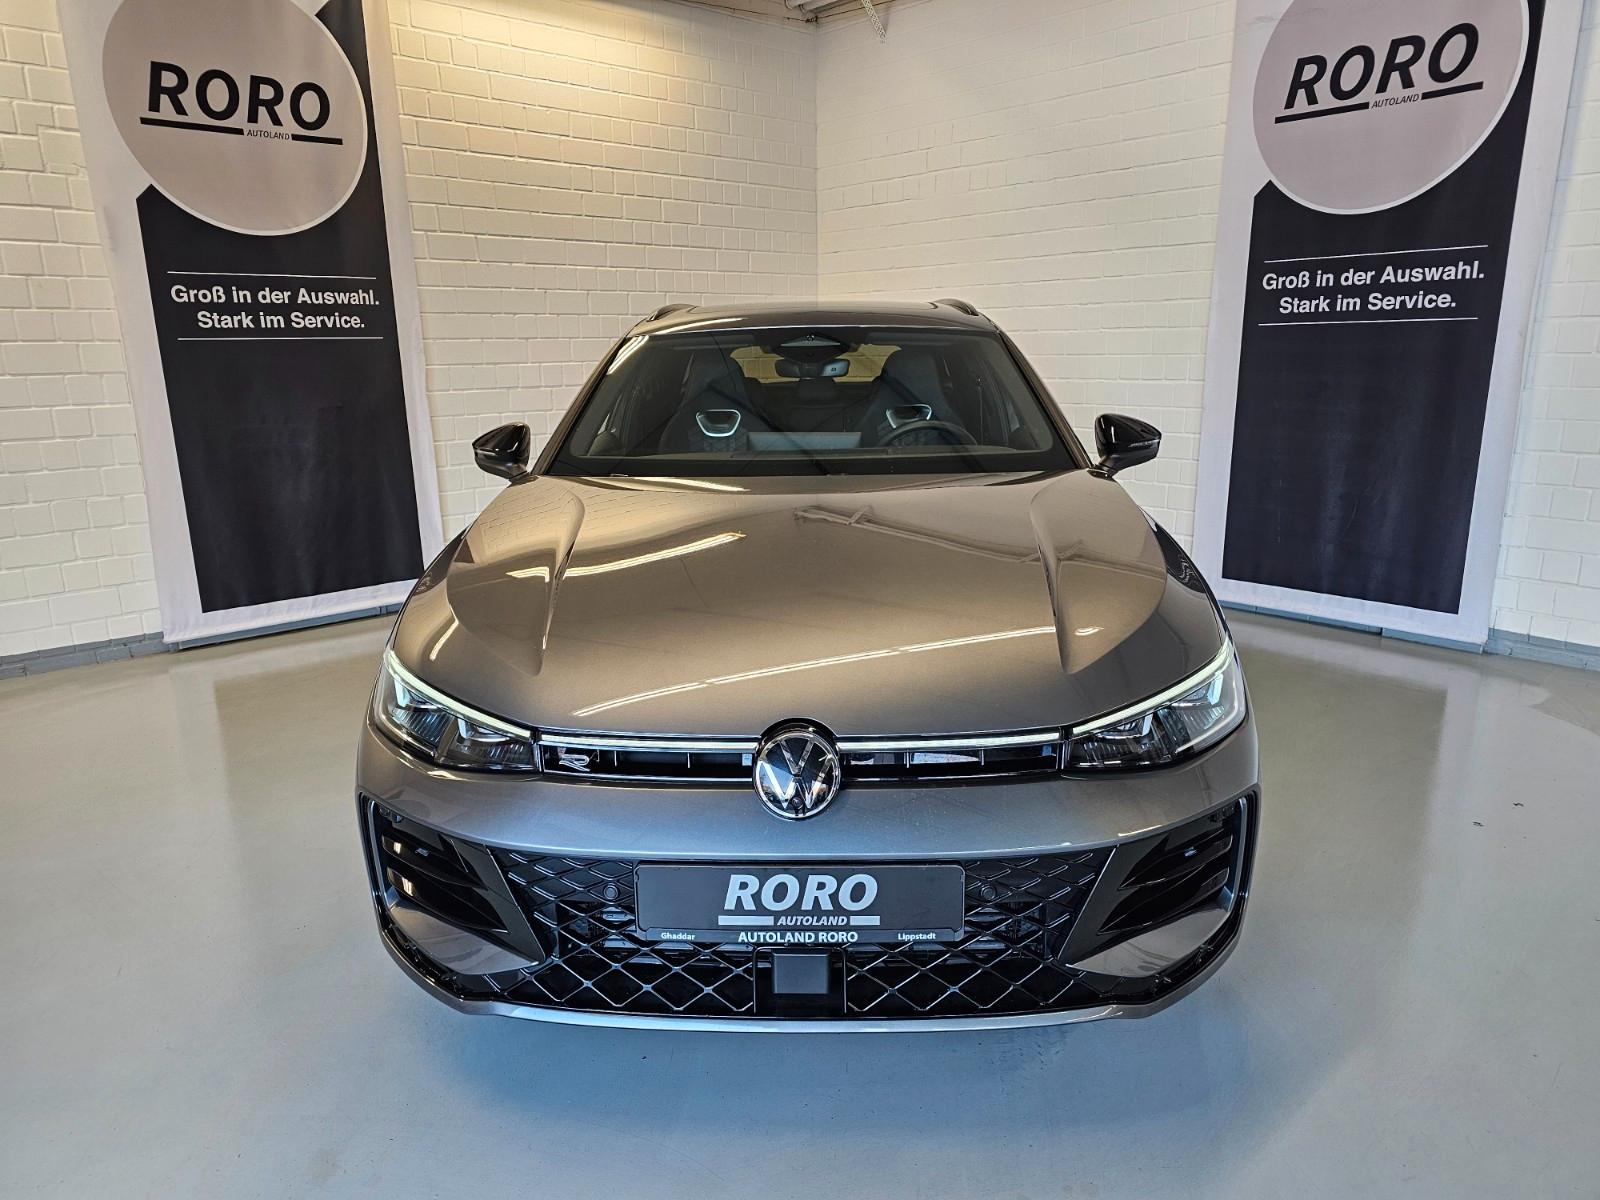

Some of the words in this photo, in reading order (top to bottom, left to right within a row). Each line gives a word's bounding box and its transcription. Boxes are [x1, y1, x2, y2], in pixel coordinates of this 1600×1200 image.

[1284, 22, 1479, 110] RORO
[148, 60, 331, 131] RORO
[1371, 93, 1420, 109] AUTOLAND
[246, 129, 290, 141] AUTOLAND
[1262, 270, 1311, 290] Groß
[1315, 270, 1334, 287] in
[1340, 268, 1376, 286] der
[1379, 260, 1486, 284] Auswahl.
[170, 285, 225, 303] Groß
[231, 286, 252, 303] in
[257, 287, 291, 304] der
[297, 288, 380, 305] Auswahl.
[1279, 296, 1331, 314] Stark
[1336, 294, 1361, 312] im
[1367, 291, 1457, 311] Service.
[197, 310, 254, 329] Stark
[260, 311, 285, 328] im
[290, 312, 365, 329] Service.
[723, 873, 878, 912] RORO
[777, 915, 848, 926] AUTOLAND
[660, 931, 696, 941] Ghaddar
[738, 931, 817, 943] AUTOLAND
[818, 931, 859, 943] RORO
[897, 931, 937, 942] Lippstadt
